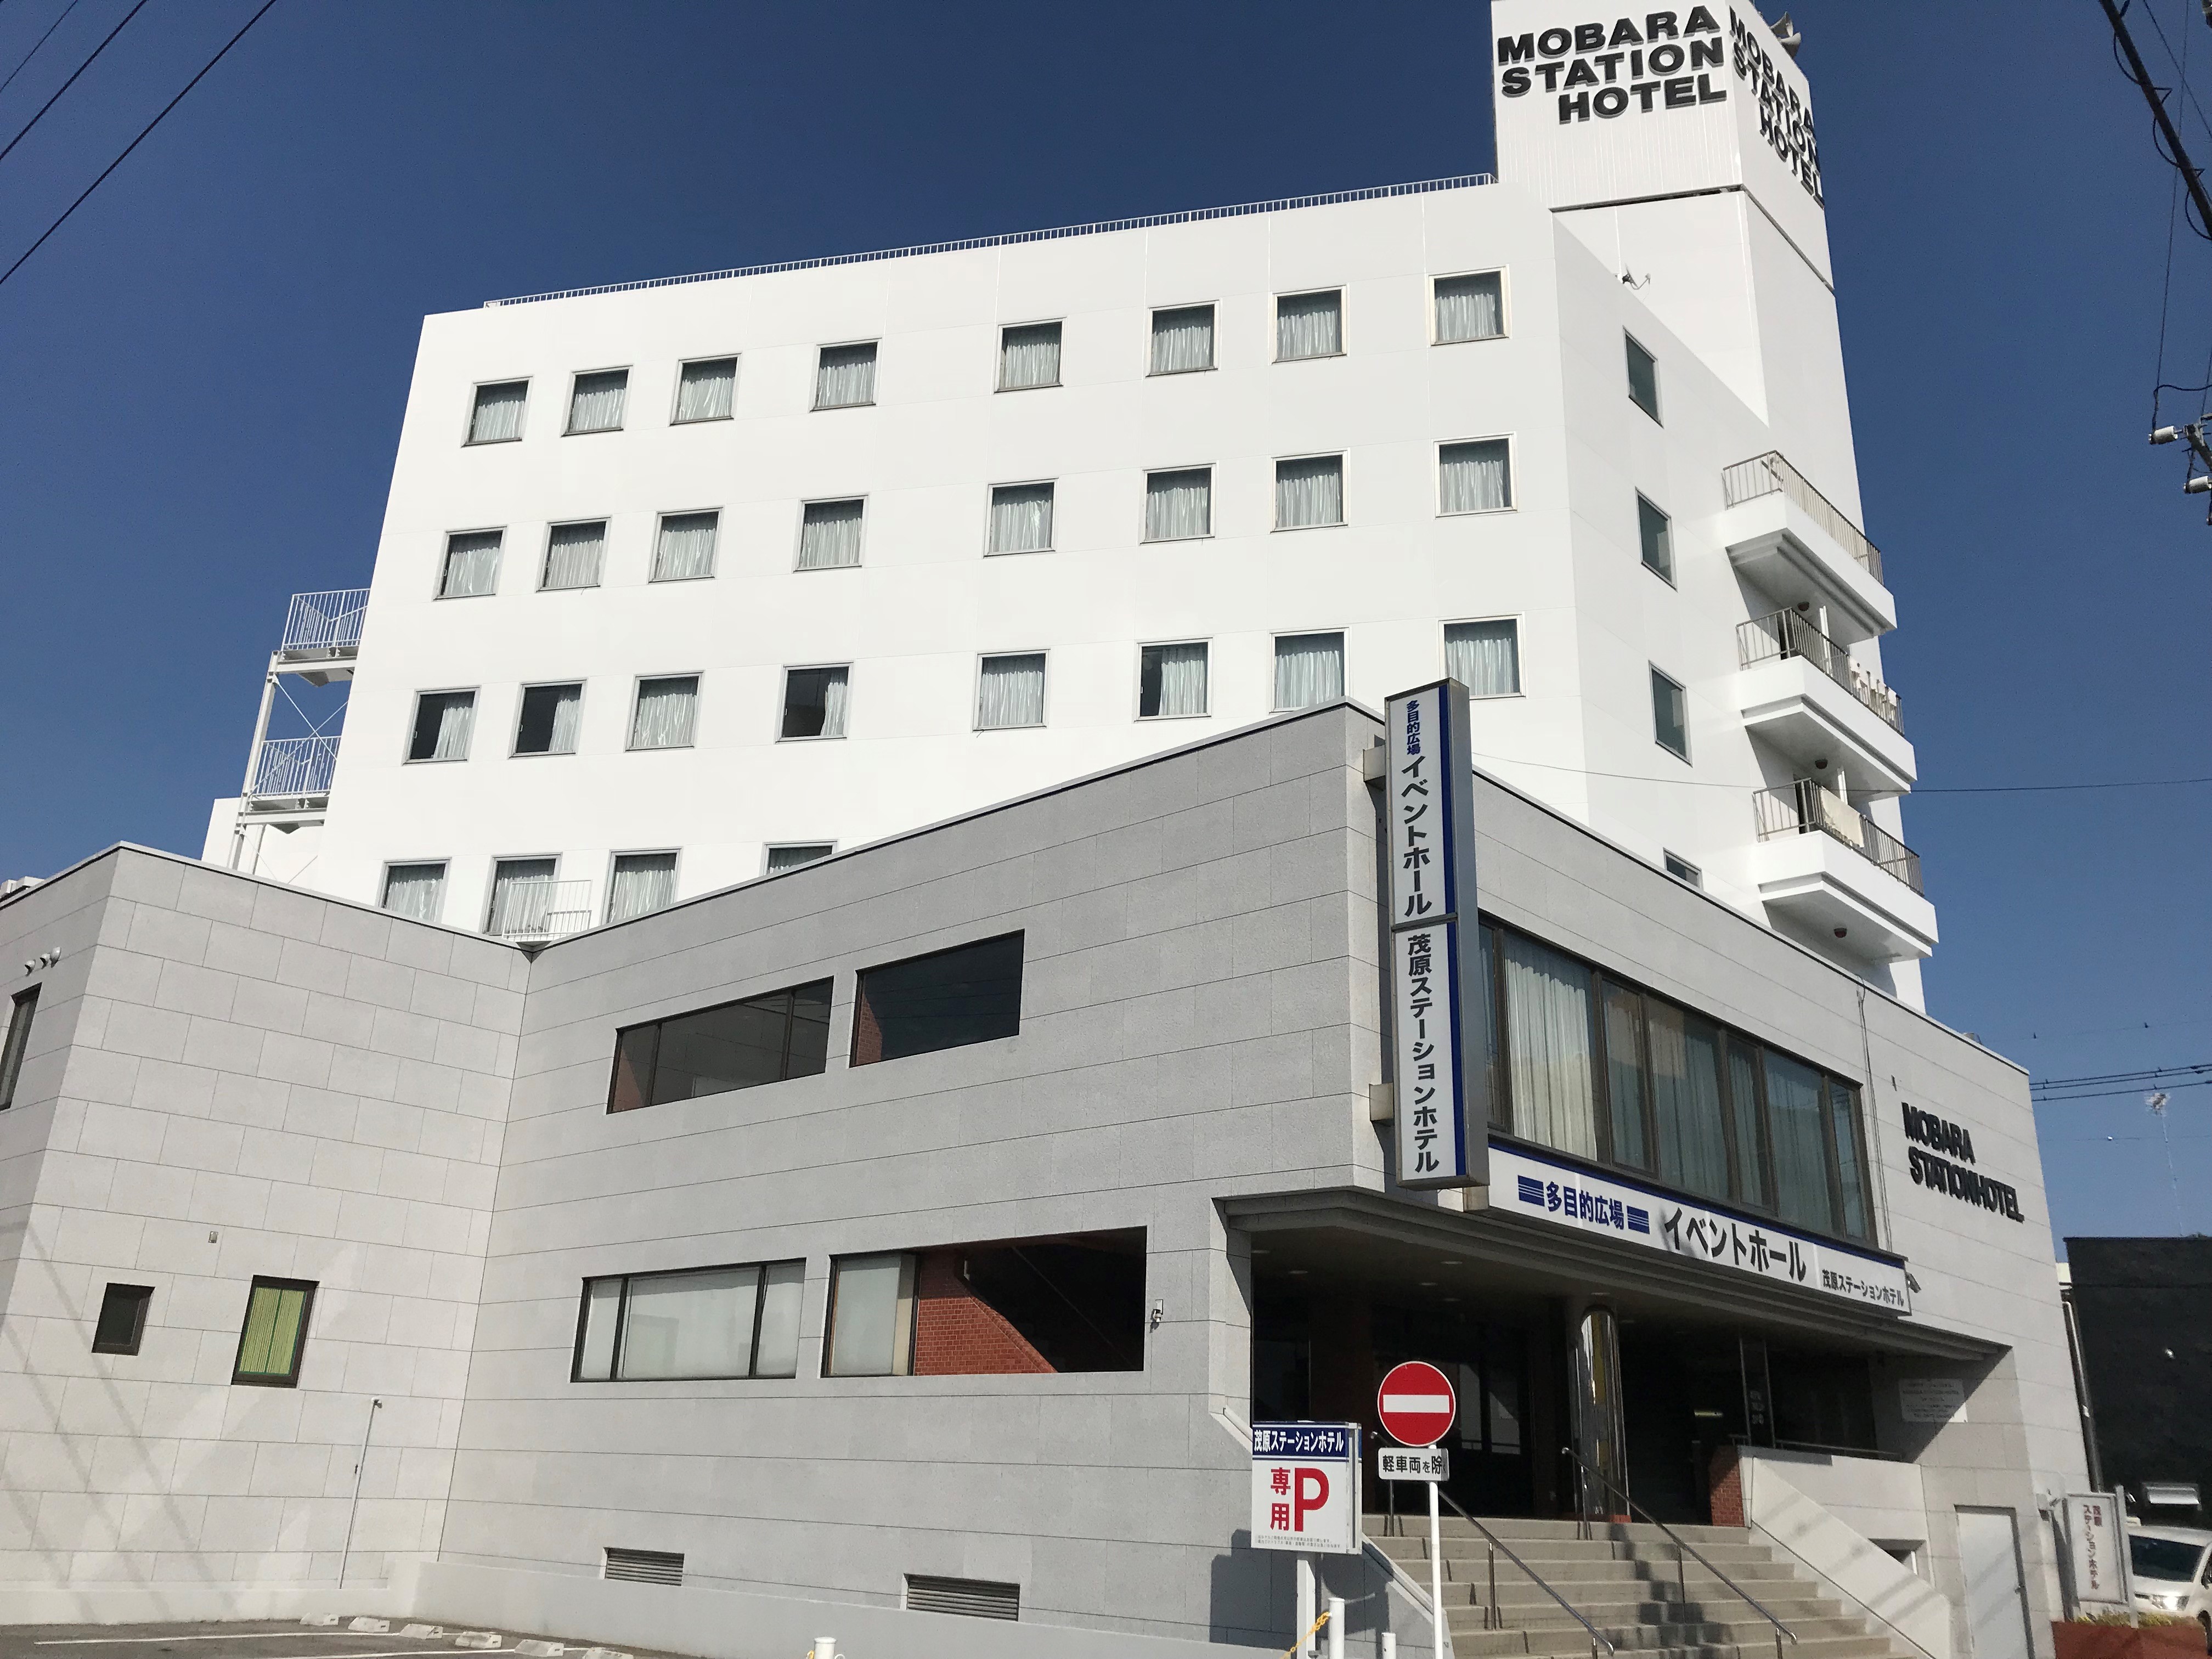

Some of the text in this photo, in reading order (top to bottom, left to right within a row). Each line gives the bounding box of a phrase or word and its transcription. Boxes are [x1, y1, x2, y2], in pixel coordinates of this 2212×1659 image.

[1498, 6, 1720, 65] MOBARA
[1502, 37, 1725, 97] STATION
[1559, 74, 1726, 124] HOTEL
[1729, 7, 1816, 144] MOBARA
[1733, 42, 1820, 175] STATION
[1760, 104, 1824, 208] HOTEL
[1401, 700, 1432, 917] 多目的広場 イベントホール
[1408, 934, 1439, 1173] 茂原ステーションホテル
[1901, 1102, 1976, 1166] MOBARA
[1547, 1181, 1904, 1307] 多目的広場 イベントホール 茂原ステーションホテル
[1254, 1430, 1344, 1453] 茂原ステーションホテル
[1271, 1467, 1291, 1531] 専用
[1295, 1468, 1329, 1532] P
